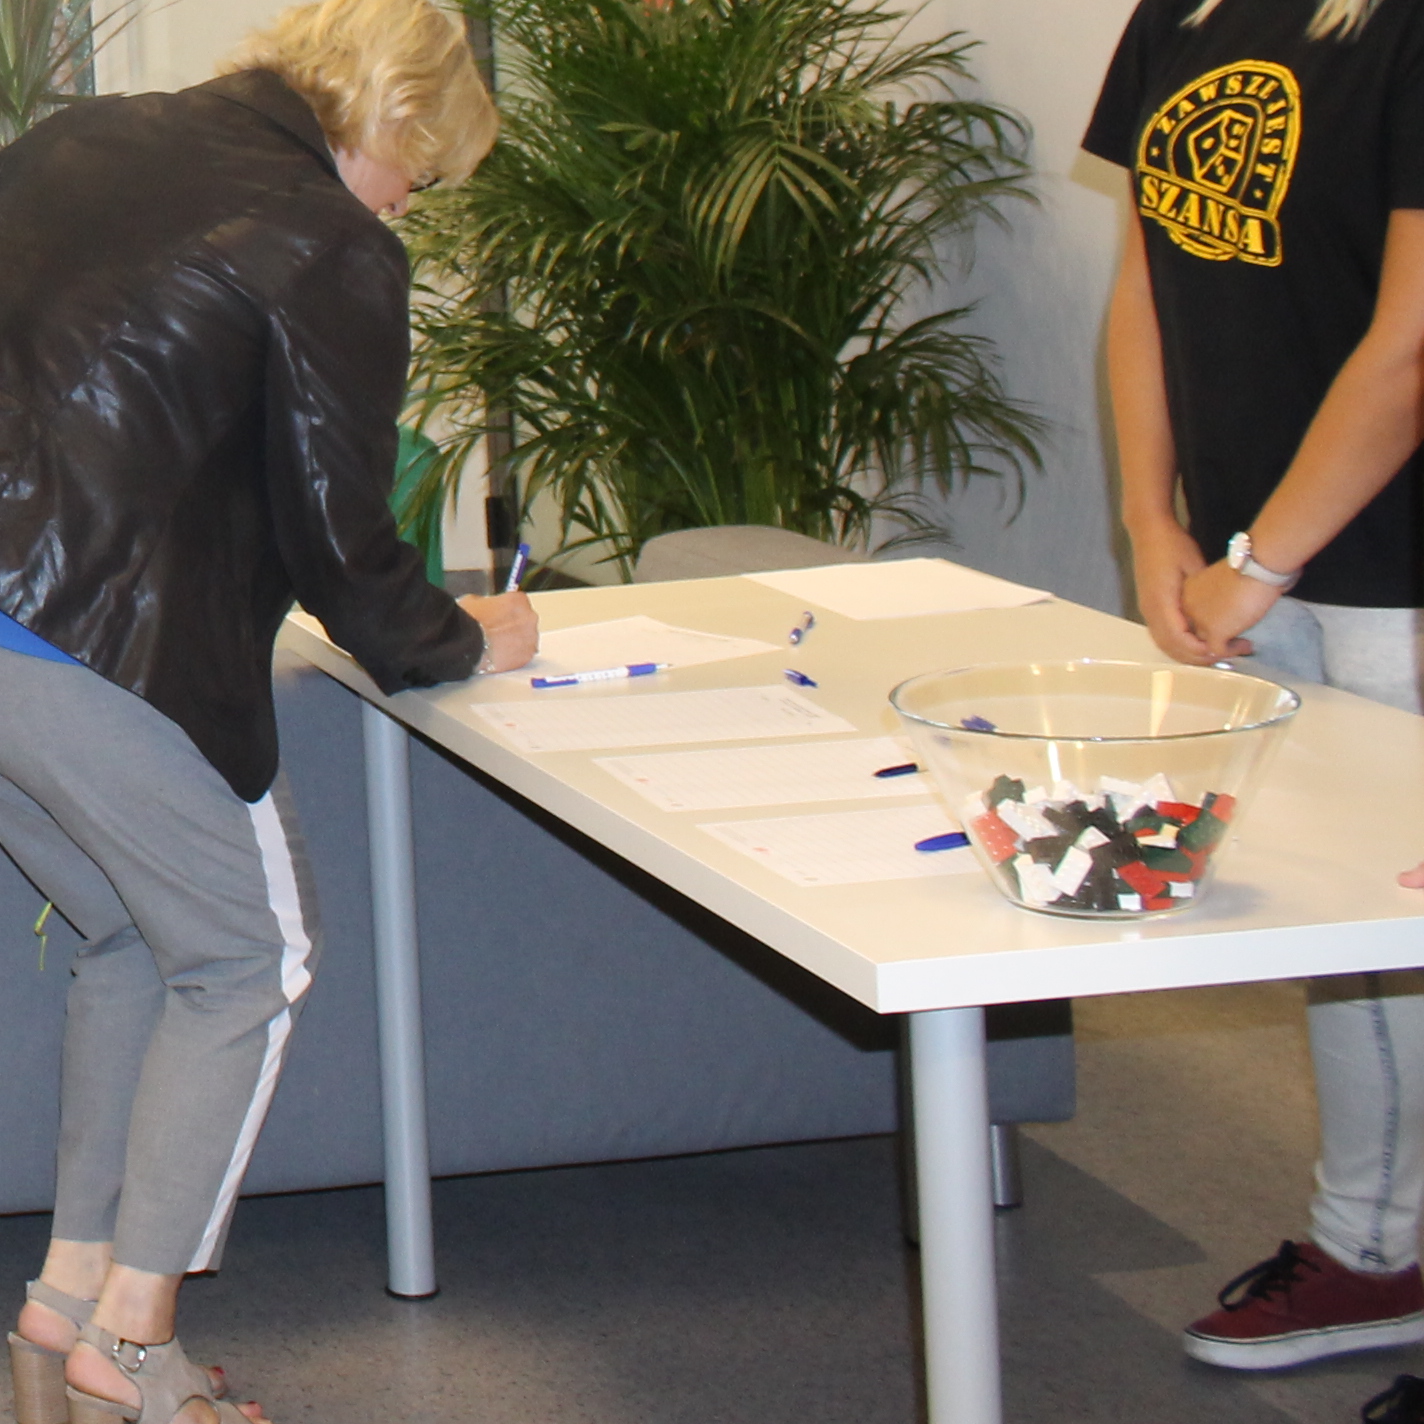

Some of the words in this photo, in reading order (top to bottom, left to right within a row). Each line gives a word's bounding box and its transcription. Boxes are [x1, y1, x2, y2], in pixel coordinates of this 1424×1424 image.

[1156, 75, 1280, 135] ZAWSZE
[1255, 98, 1288, 183] JEST
[1141, 174, 1266, 255] SZANSA
